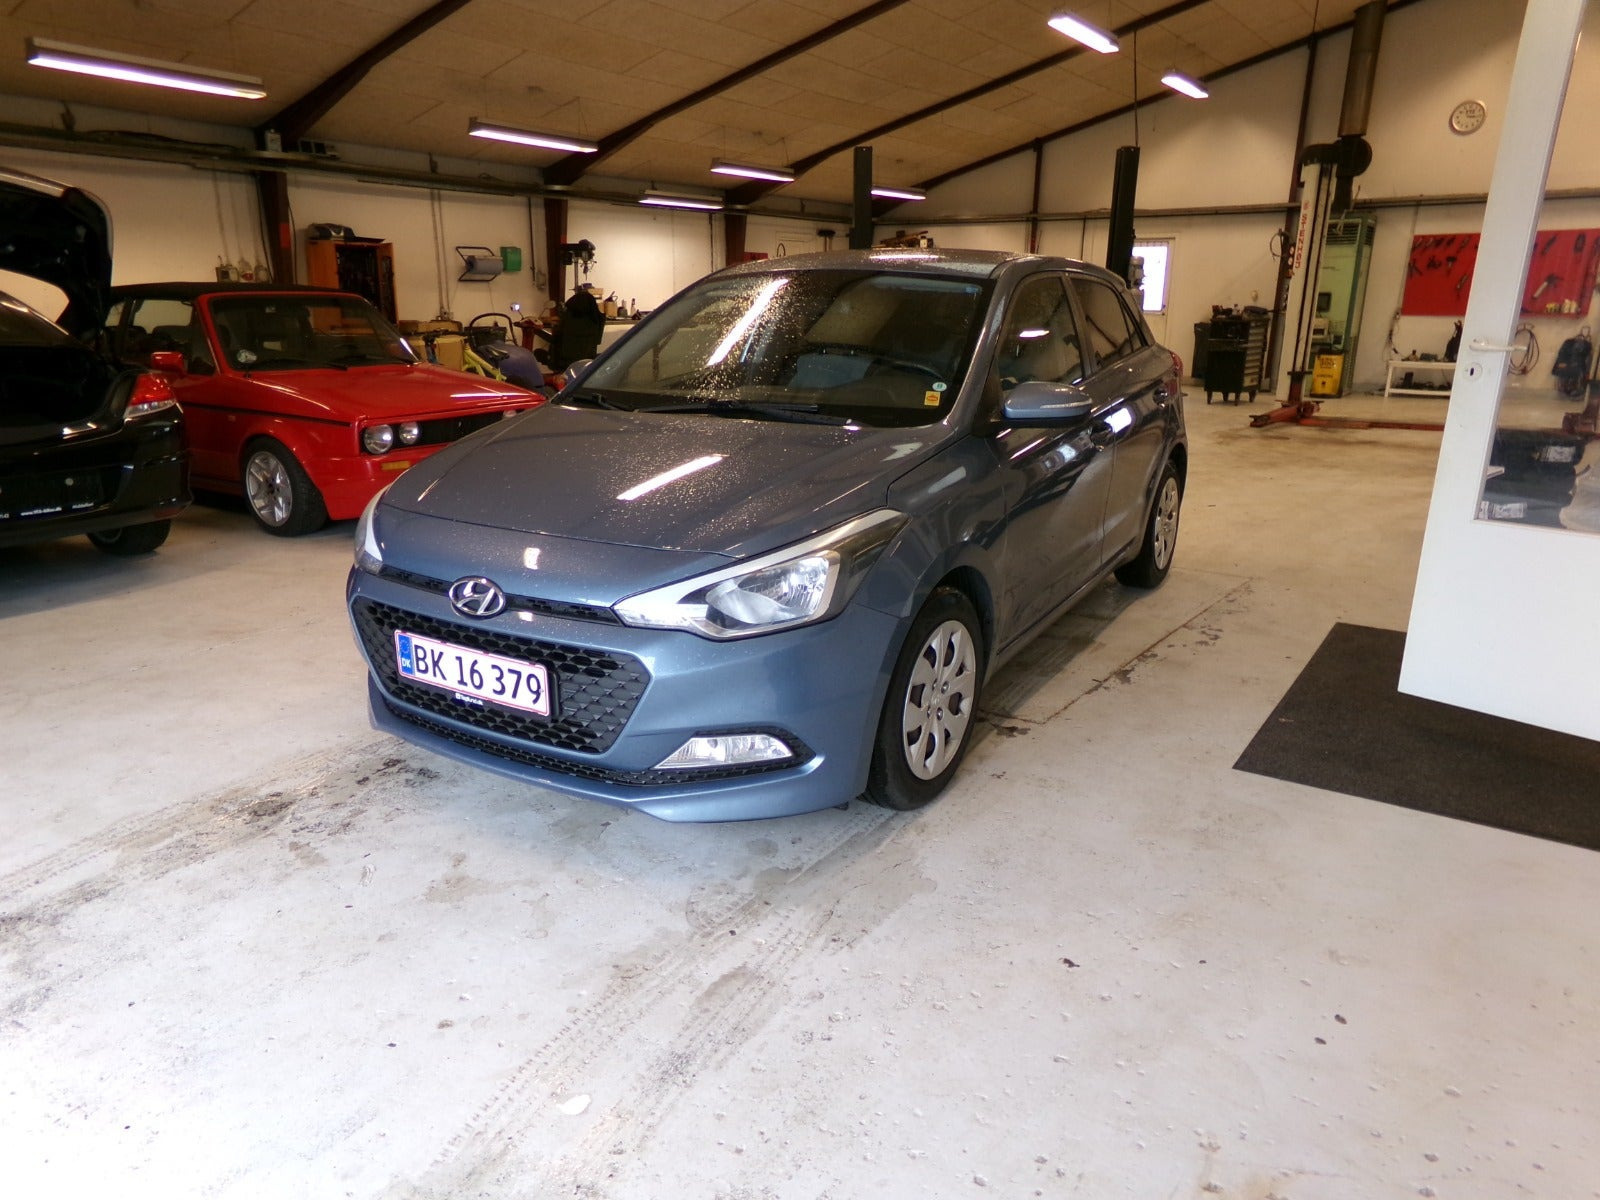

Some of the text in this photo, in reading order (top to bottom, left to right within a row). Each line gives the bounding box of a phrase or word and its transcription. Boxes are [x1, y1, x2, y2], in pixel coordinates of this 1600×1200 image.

[401, 658, 412, 669] DK
[414, 644, 542, 705] BK 16 379
